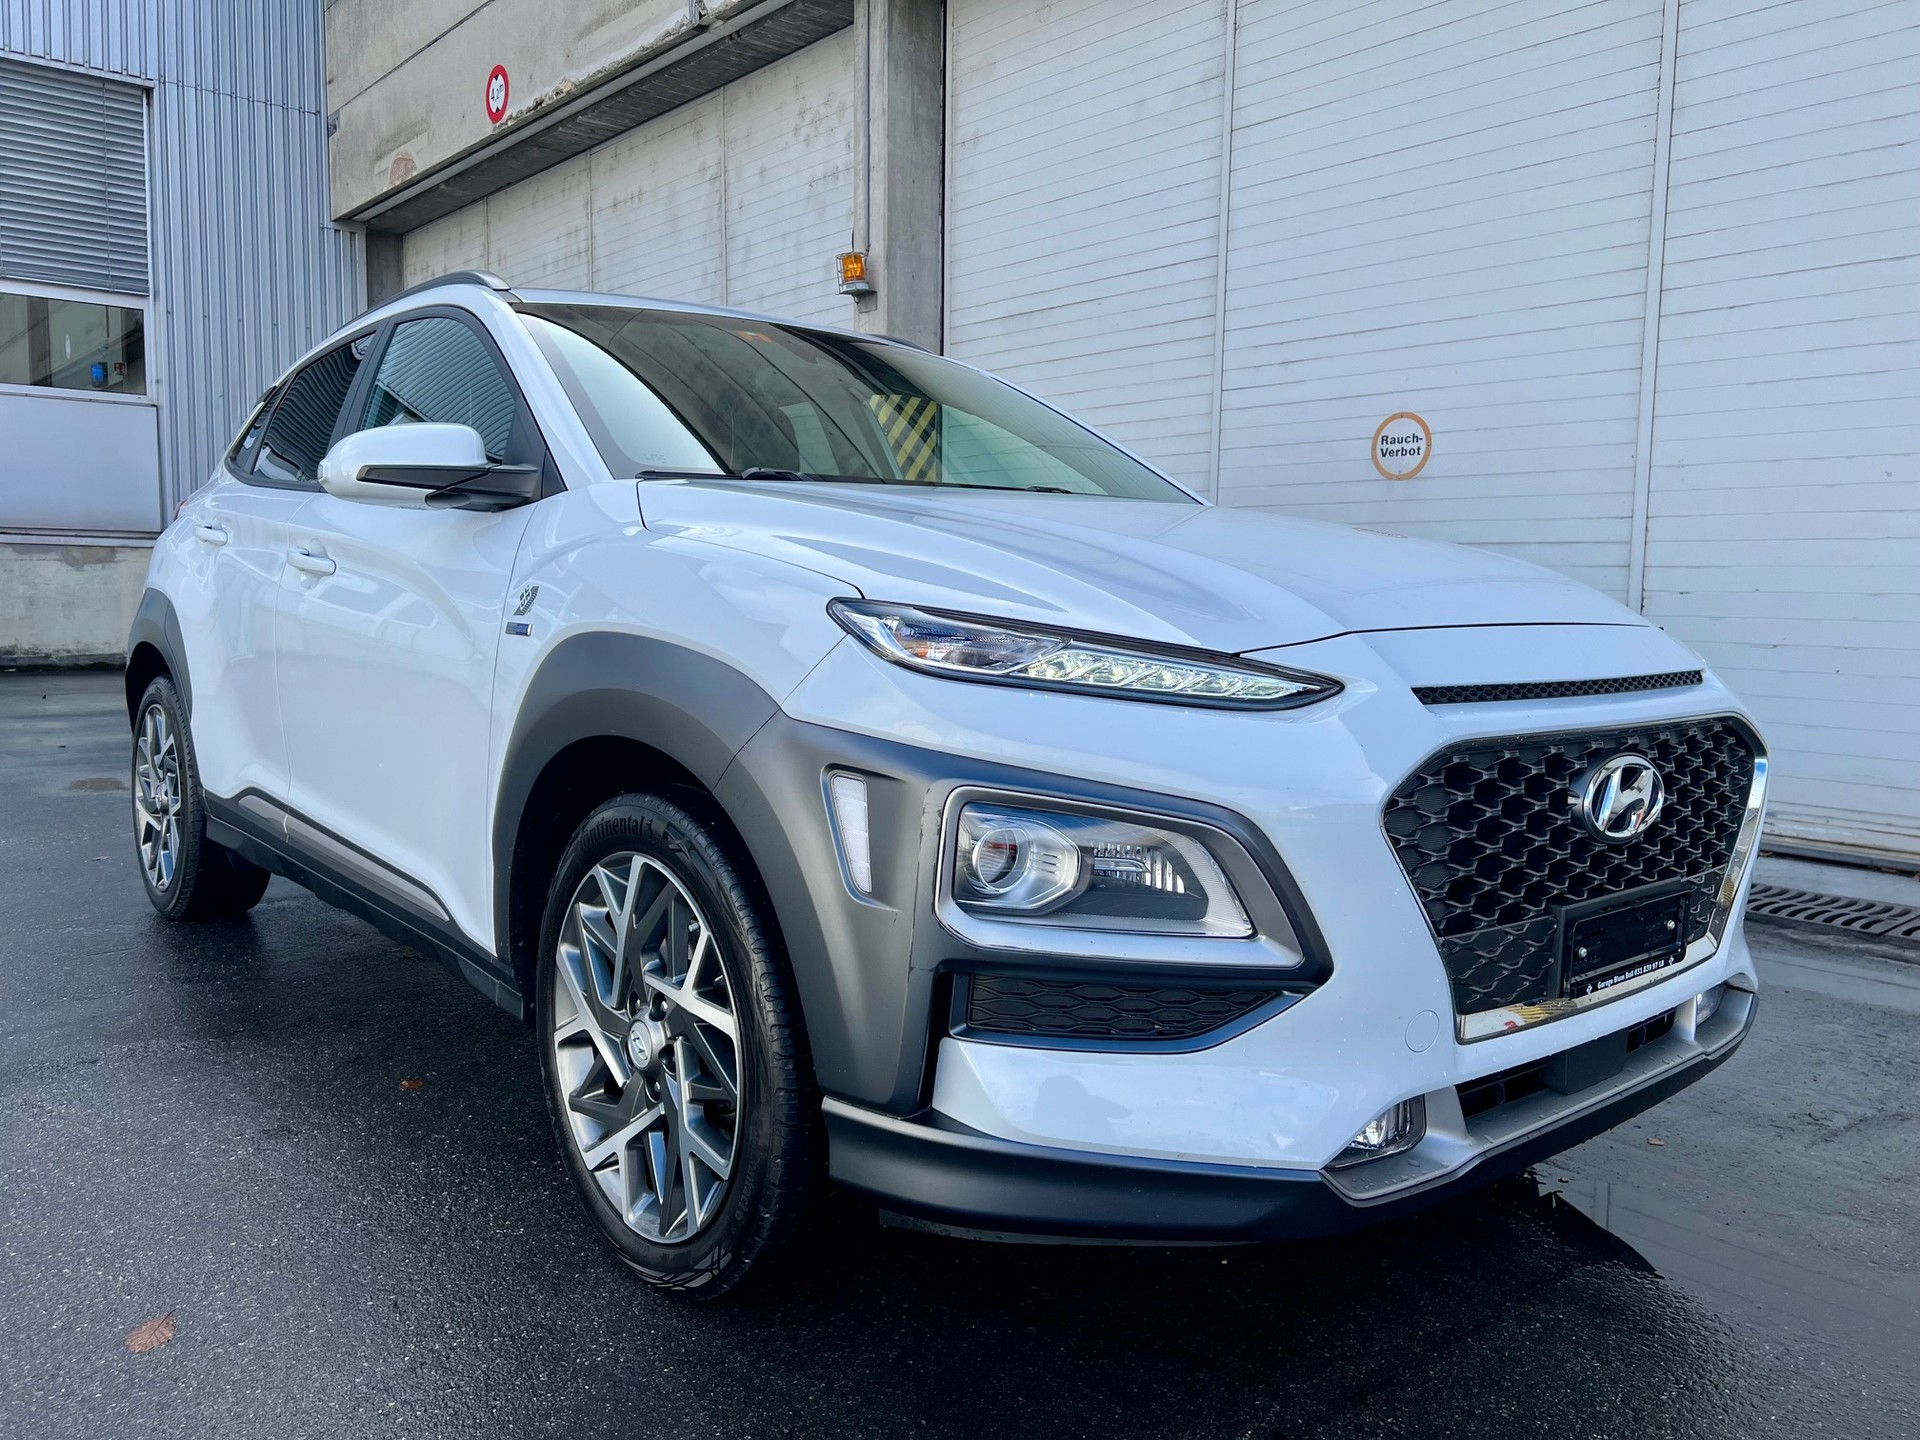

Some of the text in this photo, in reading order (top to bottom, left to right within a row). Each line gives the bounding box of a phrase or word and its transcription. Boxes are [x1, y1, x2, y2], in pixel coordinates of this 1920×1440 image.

[1381, 433, 1424, 446] Rauch-
[1380, 446, 1421, 458] Verbot
[1597, 980, 1613, 989] Garage
